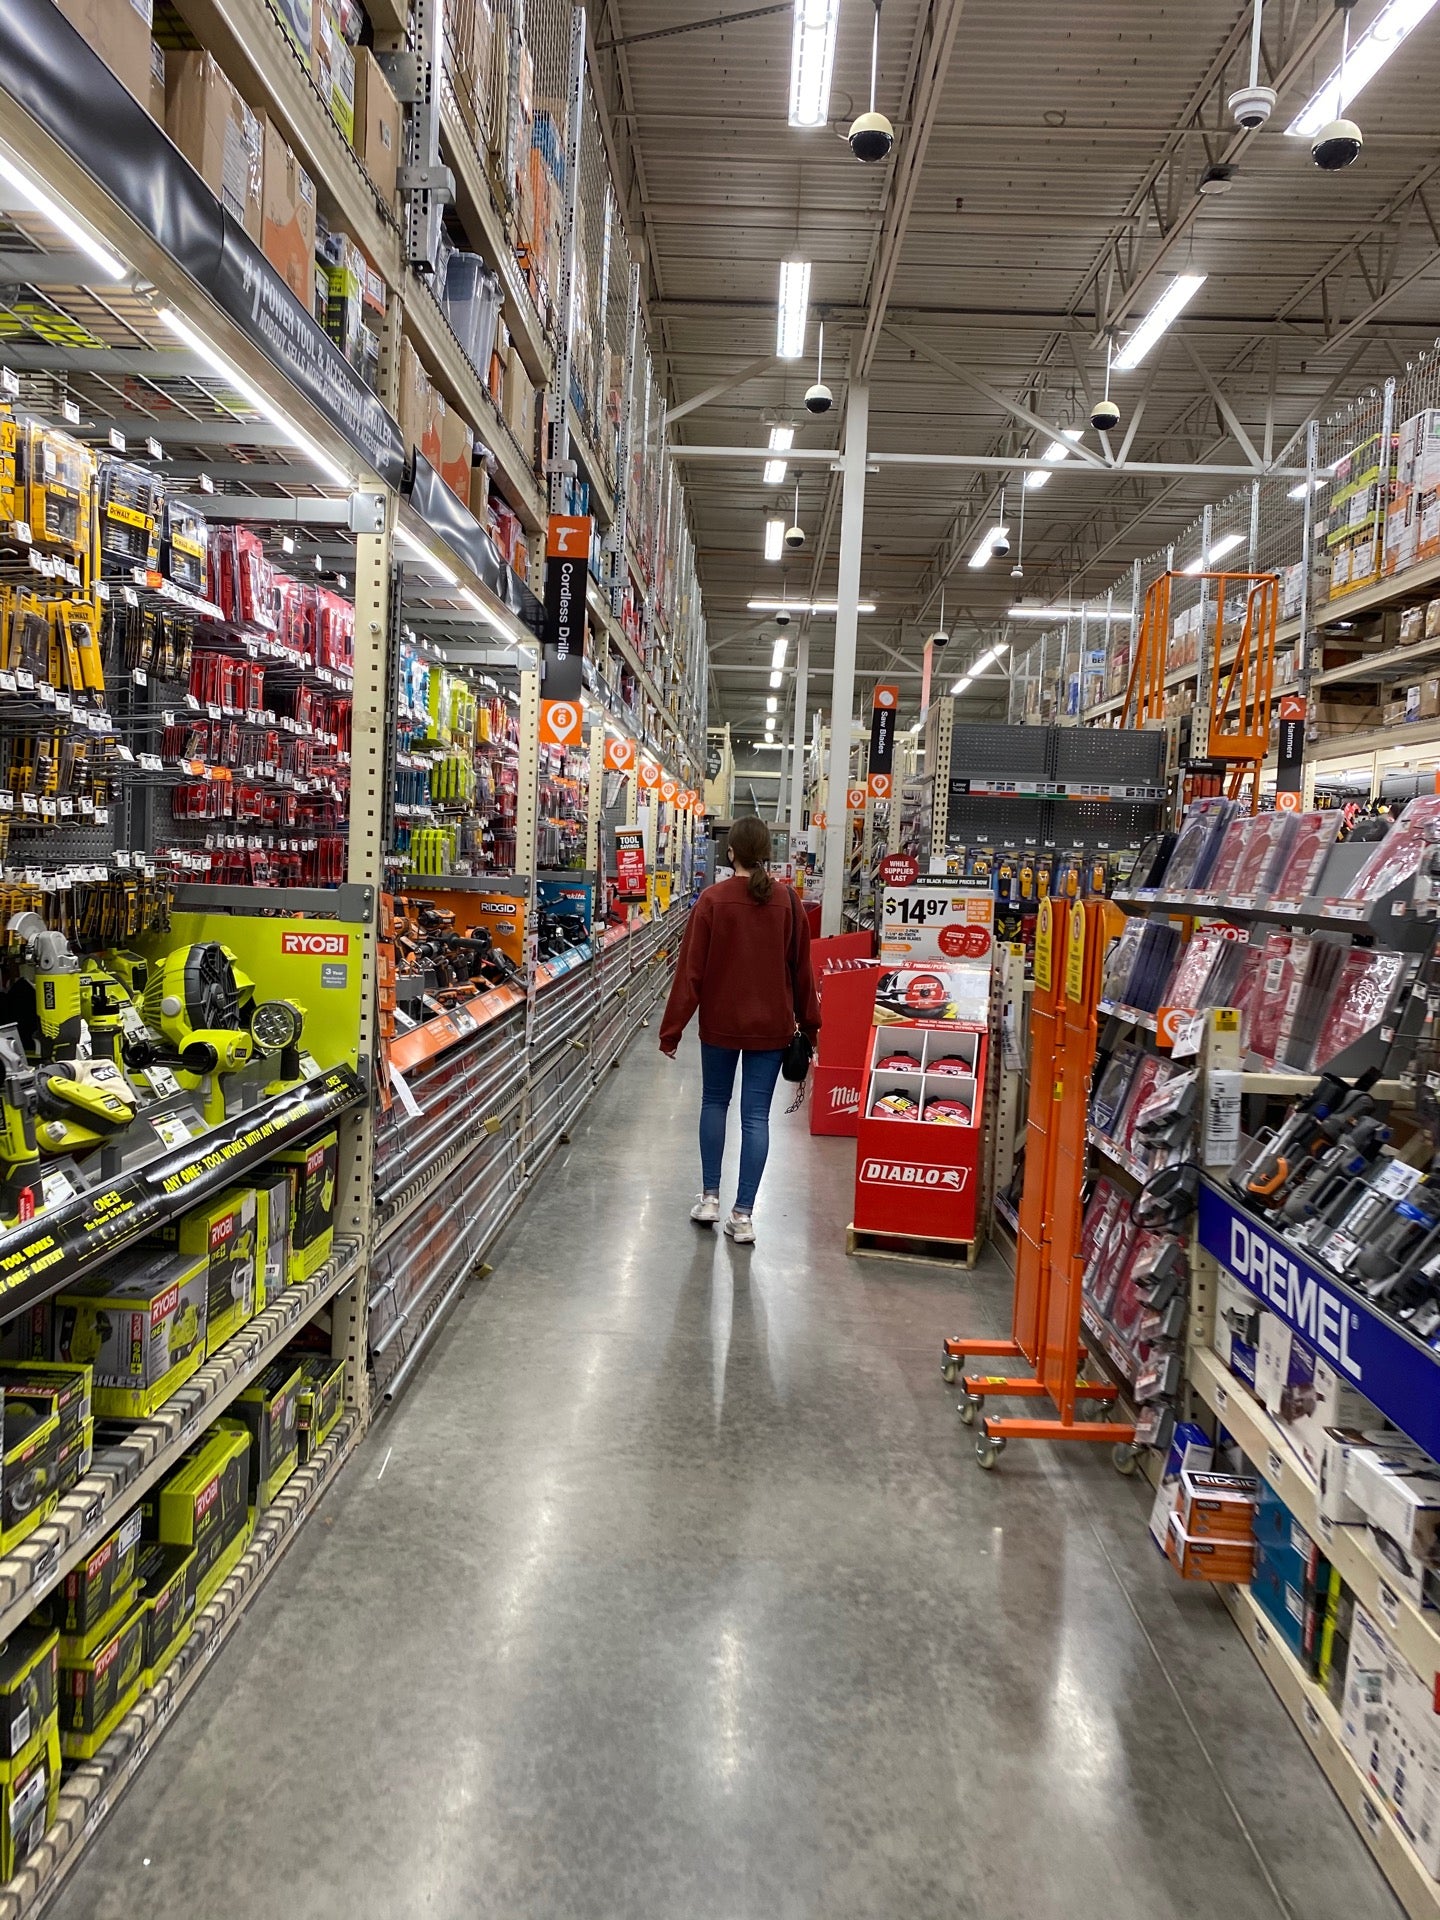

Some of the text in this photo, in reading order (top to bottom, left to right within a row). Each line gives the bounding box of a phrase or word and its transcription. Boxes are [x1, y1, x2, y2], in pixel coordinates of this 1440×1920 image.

[258, 309, 287, 357] NOBODY
[286, 343, 305, 373] SELLS
[304, 361, 324, 393] MORE
[321, 379, 341, 415] POWER
[340, 401, 356, 431] TOOLS
[263, 276, 295, 334] POWER
[295, 316, 317, 361] TOOL
[317, 343, 325, 367] &
[325, 350, 364, 410] ACCESSORY
[362, 398, 393, 447] RETAILER
[557, 562, 573, 661] Cordless Drills
[557, 713, 567, 725] 6
[878, 711, 889, 754] Saw Blades
[1286, 722, 1296, 759] Hammers
[620, 836, 640, 845] TOOL
[884, 867, 914, 875] SUPPLIES
[889, 860, 910, 868] WHILE
[890, 874, 907, 882] LAST
[481, 902, 516, 913] RIDGID
[285, 935, 344, 953] RYOBI
[943, 1003, 958, 1019] 2
[162, 1177, 183, 1194] ANY
[202, 1149, 224, 1172] TOOL
[222, 1138, 247, 1161] WORKS
[245, 1130, 263, 1147] WITH
[260, 1122, 275, 1141] ANY
[288, 1102, 311, 1125] BATTERY
[307, 1149, 324, 1171] RYOBI
[867, 1164, 939, 1184] DIABLO
[84, 1222, 95, 1231] The
[93, 1215, 109, 1228] Power
[107, 1210, 115, 1218] To
[113, 1207, 122, 1215] Do
[212, 1215, 233, 1244] RYOBI
[0, 1235, 55, 1271] TOOL WORKS
[30, 1247, 65, 1274] BATTERY
[152, 1288, 177, 1320] RYOBI
[1231, 1217, 1361, 1381] DREMEL
[197, 1479, 218, 1516] RYOBI
[88, 1545, 112, 1577] RYOBI
[96, 1641, 119, 1676] RYOBI
